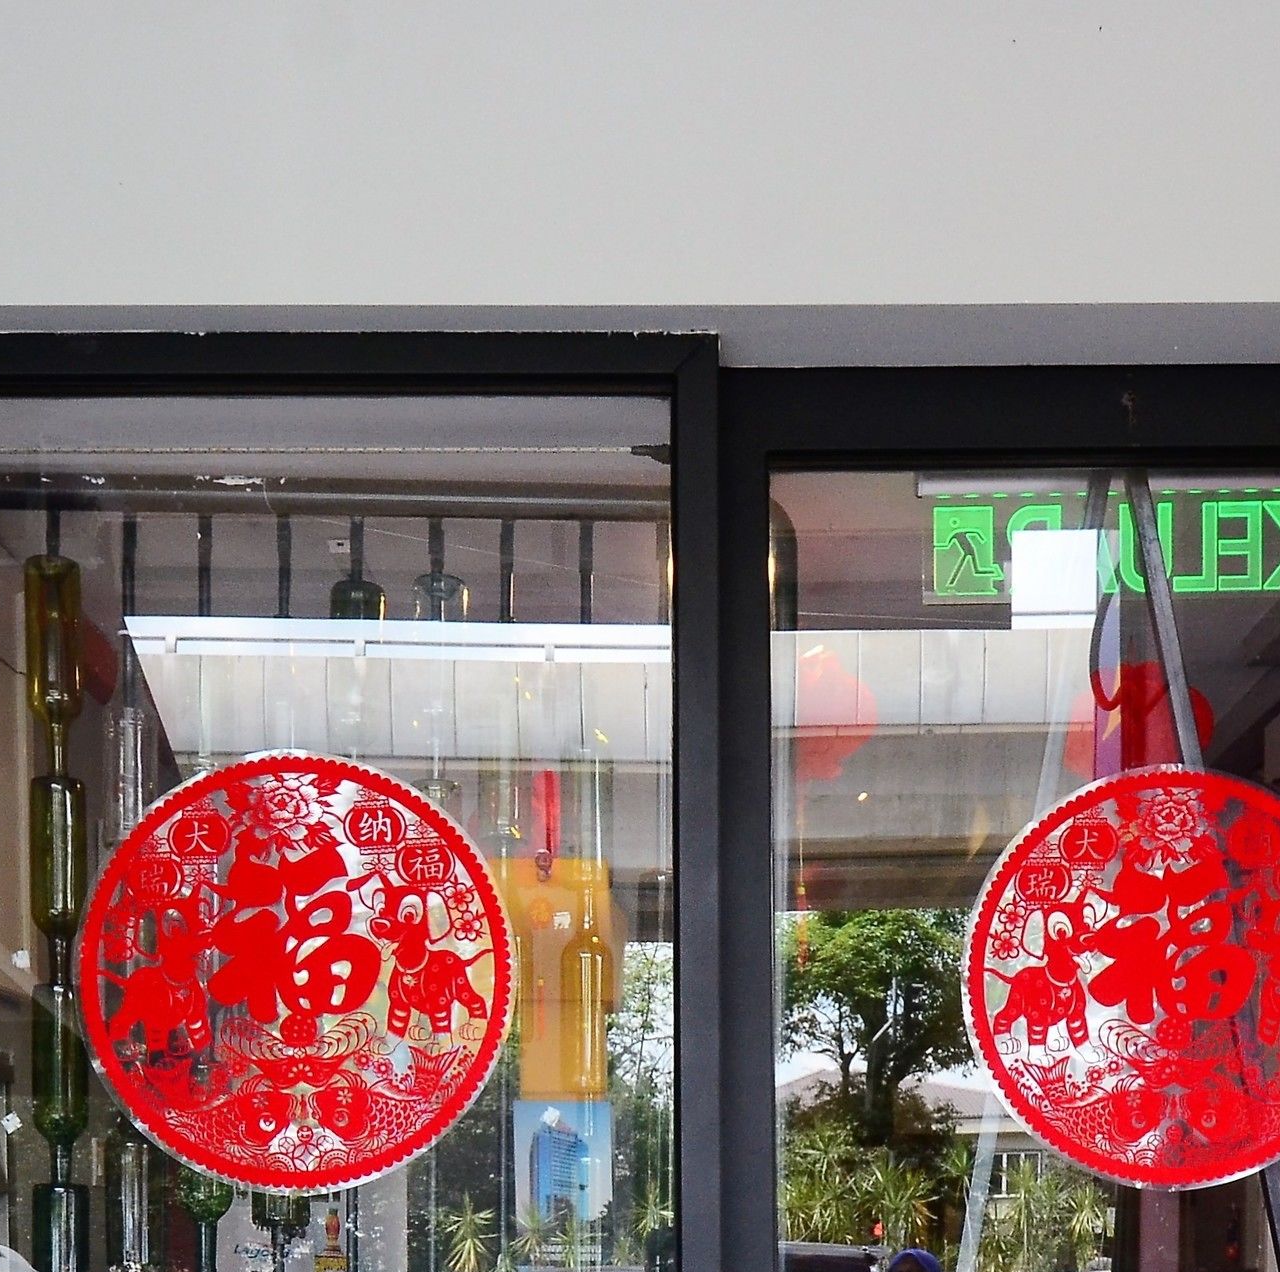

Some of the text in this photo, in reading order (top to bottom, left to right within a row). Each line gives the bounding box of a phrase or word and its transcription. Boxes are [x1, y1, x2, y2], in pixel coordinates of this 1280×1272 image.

[184, 821, 217, 852] 犬
[358, 810, 394, 843] 纳
[1075, 829, 1106, 858] 犬
[408, 852, 443, 883] 福
[208, 838, 382, 1024] 福
[1088, 856, 1257, 1024] 福
